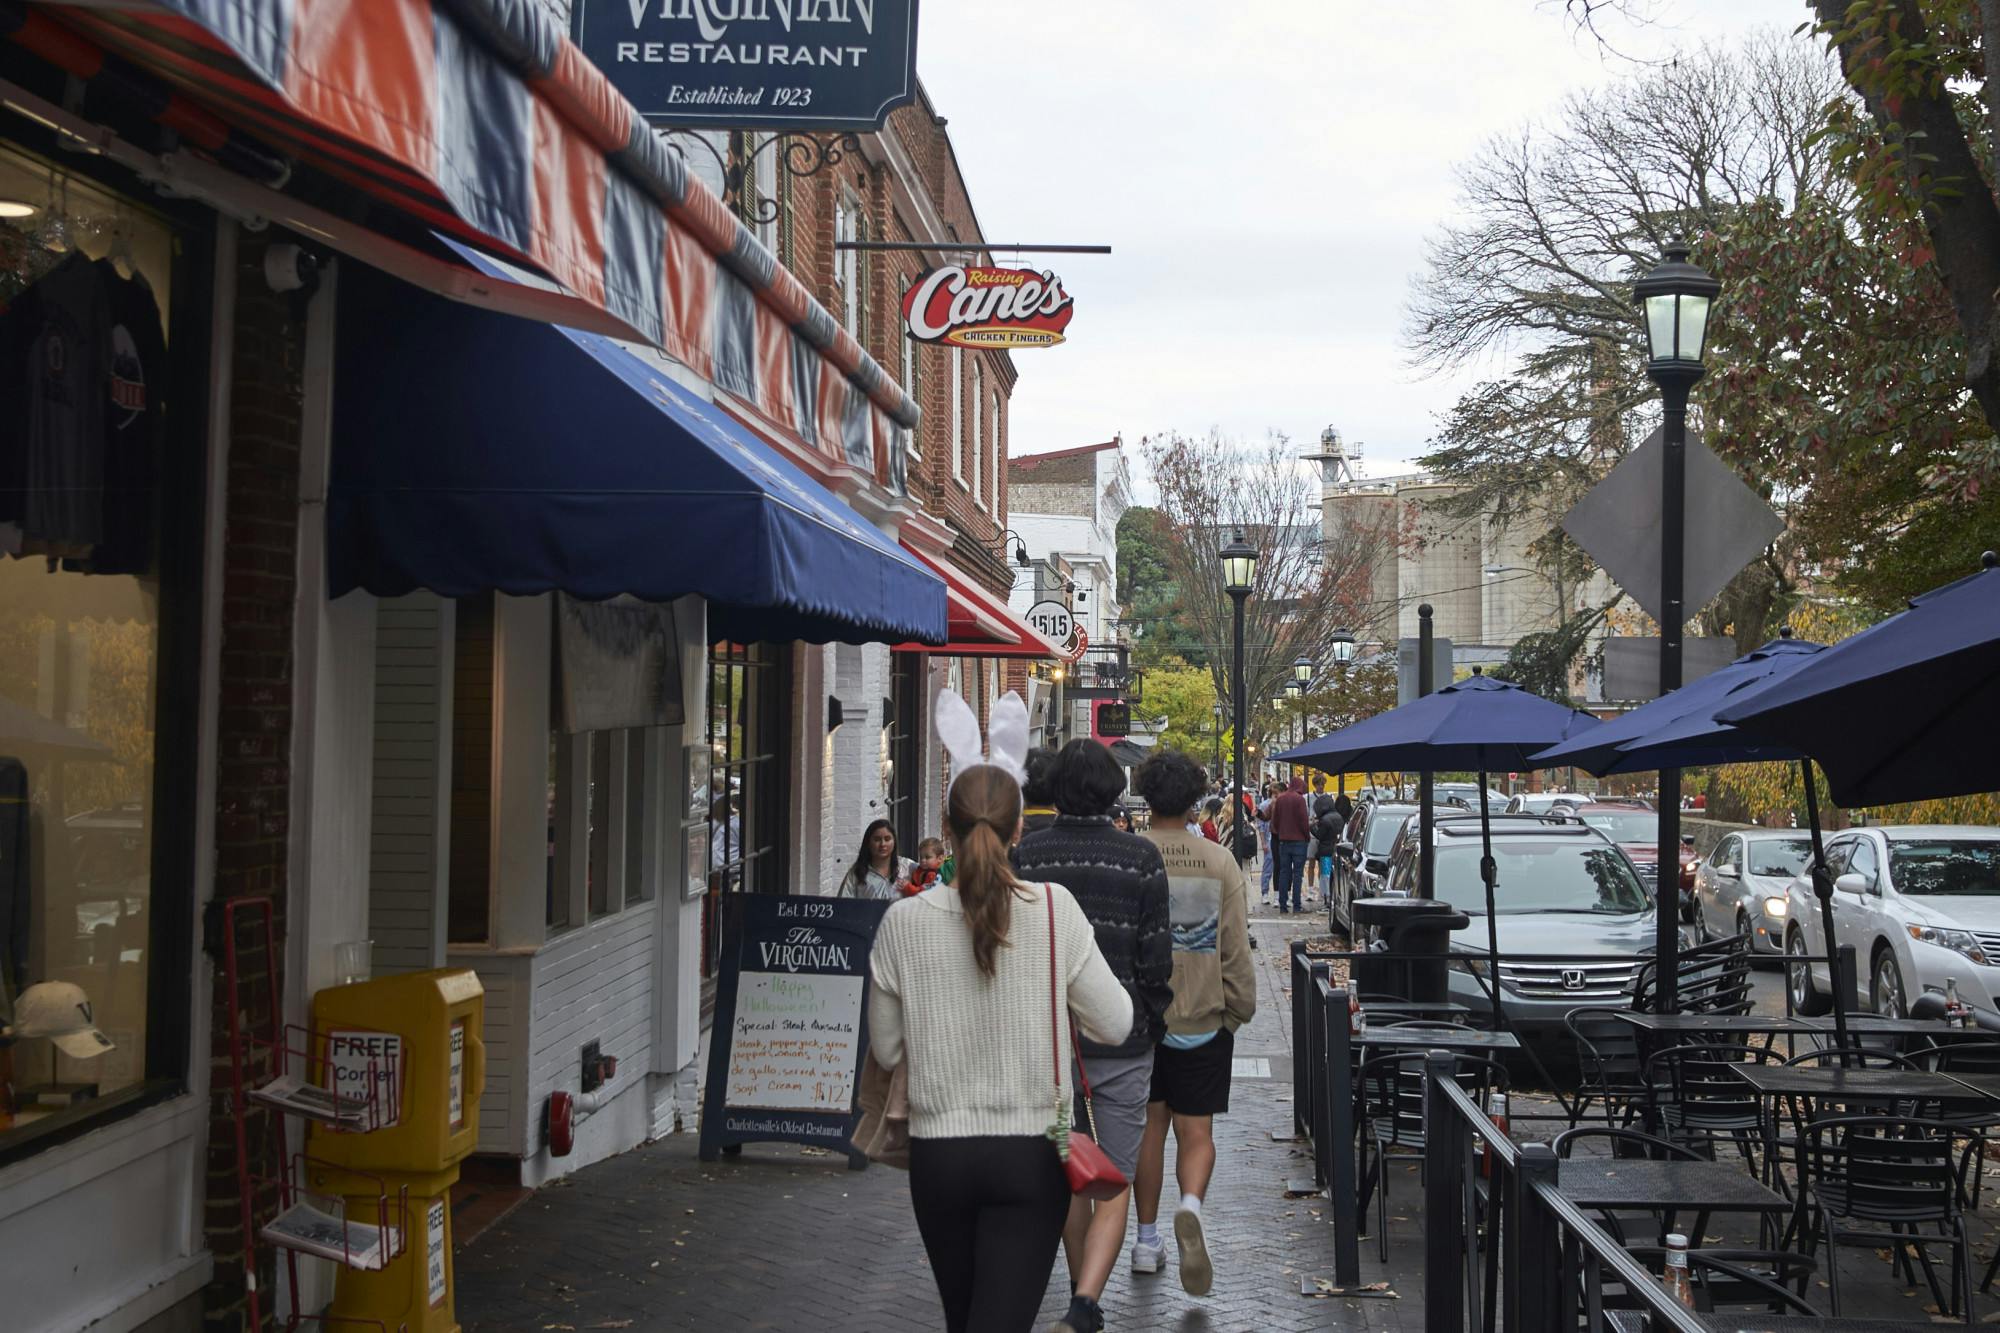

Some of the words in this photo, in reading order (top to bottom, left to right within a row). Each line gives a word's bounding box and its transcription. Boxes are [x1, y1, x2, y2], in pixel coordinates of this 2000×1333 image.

[616, 42, 868, 67] RESTAURANT
[667, 85, 764, 106] Established
[771, 87, 813, 107] 1923
[967, 269, 1025, 288] Raising
[909, 266, 1073, 340] Cane's
[777, 902, 800, 917] Est
[802, 903, 834, 919] 1923
[785, 926, 823, 945] The
[759, 941, 850, 973] VIRGINIAN
[772, 975, 814, 1000] Happy
[76, 1001, 93, 1022] V
[333, 1037, 399, 1057] FREE
[781, 1120, 805, 1135] Oldest
[806, 1122, 843, 1137] Restaurant
